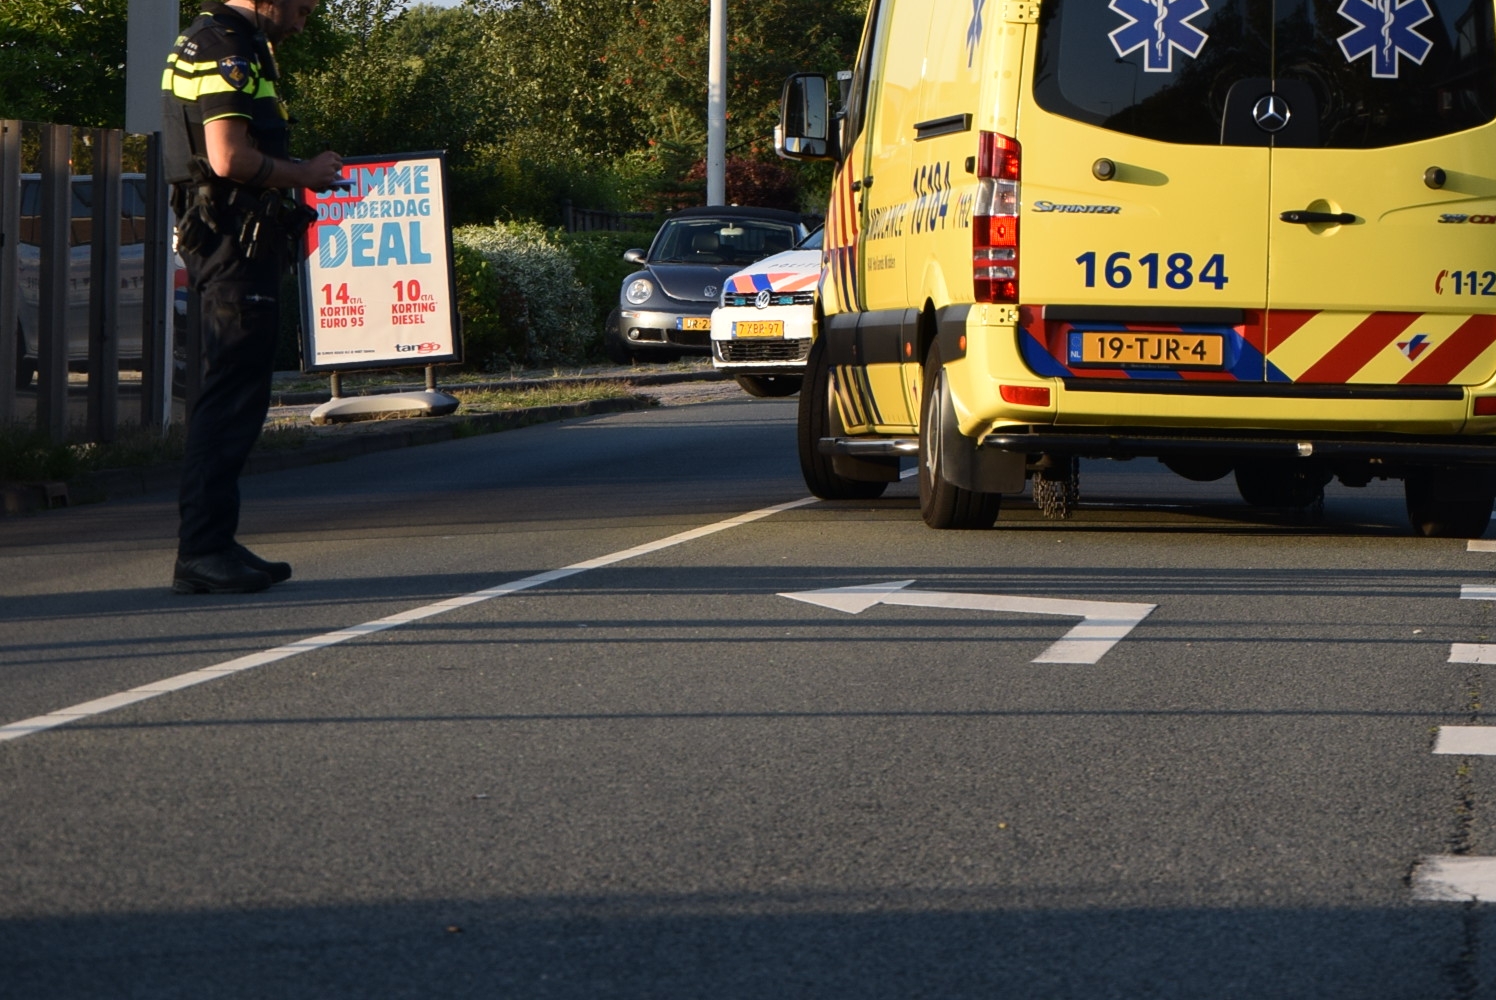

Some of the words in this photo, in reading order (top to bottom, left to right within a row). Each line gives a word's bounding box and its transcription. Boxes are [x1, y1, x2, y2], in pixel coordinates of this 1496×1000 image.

[316, 165, 430, 199] IMME
[317, 198, 431, 220] DONDERDAG
[319, 221, 432, 268] DEAL
[1075, 250, 1229, 290] 16184
[321, 283, 350, 305] 14
[393, 279, 421, 302] 10
[321, 318, 348, 328] EURO
[351, 317, 364, 327] 95
[392, 314, 425, 325] DIESEL
[1098, 337, 1206, 360] 19-TJR-4
